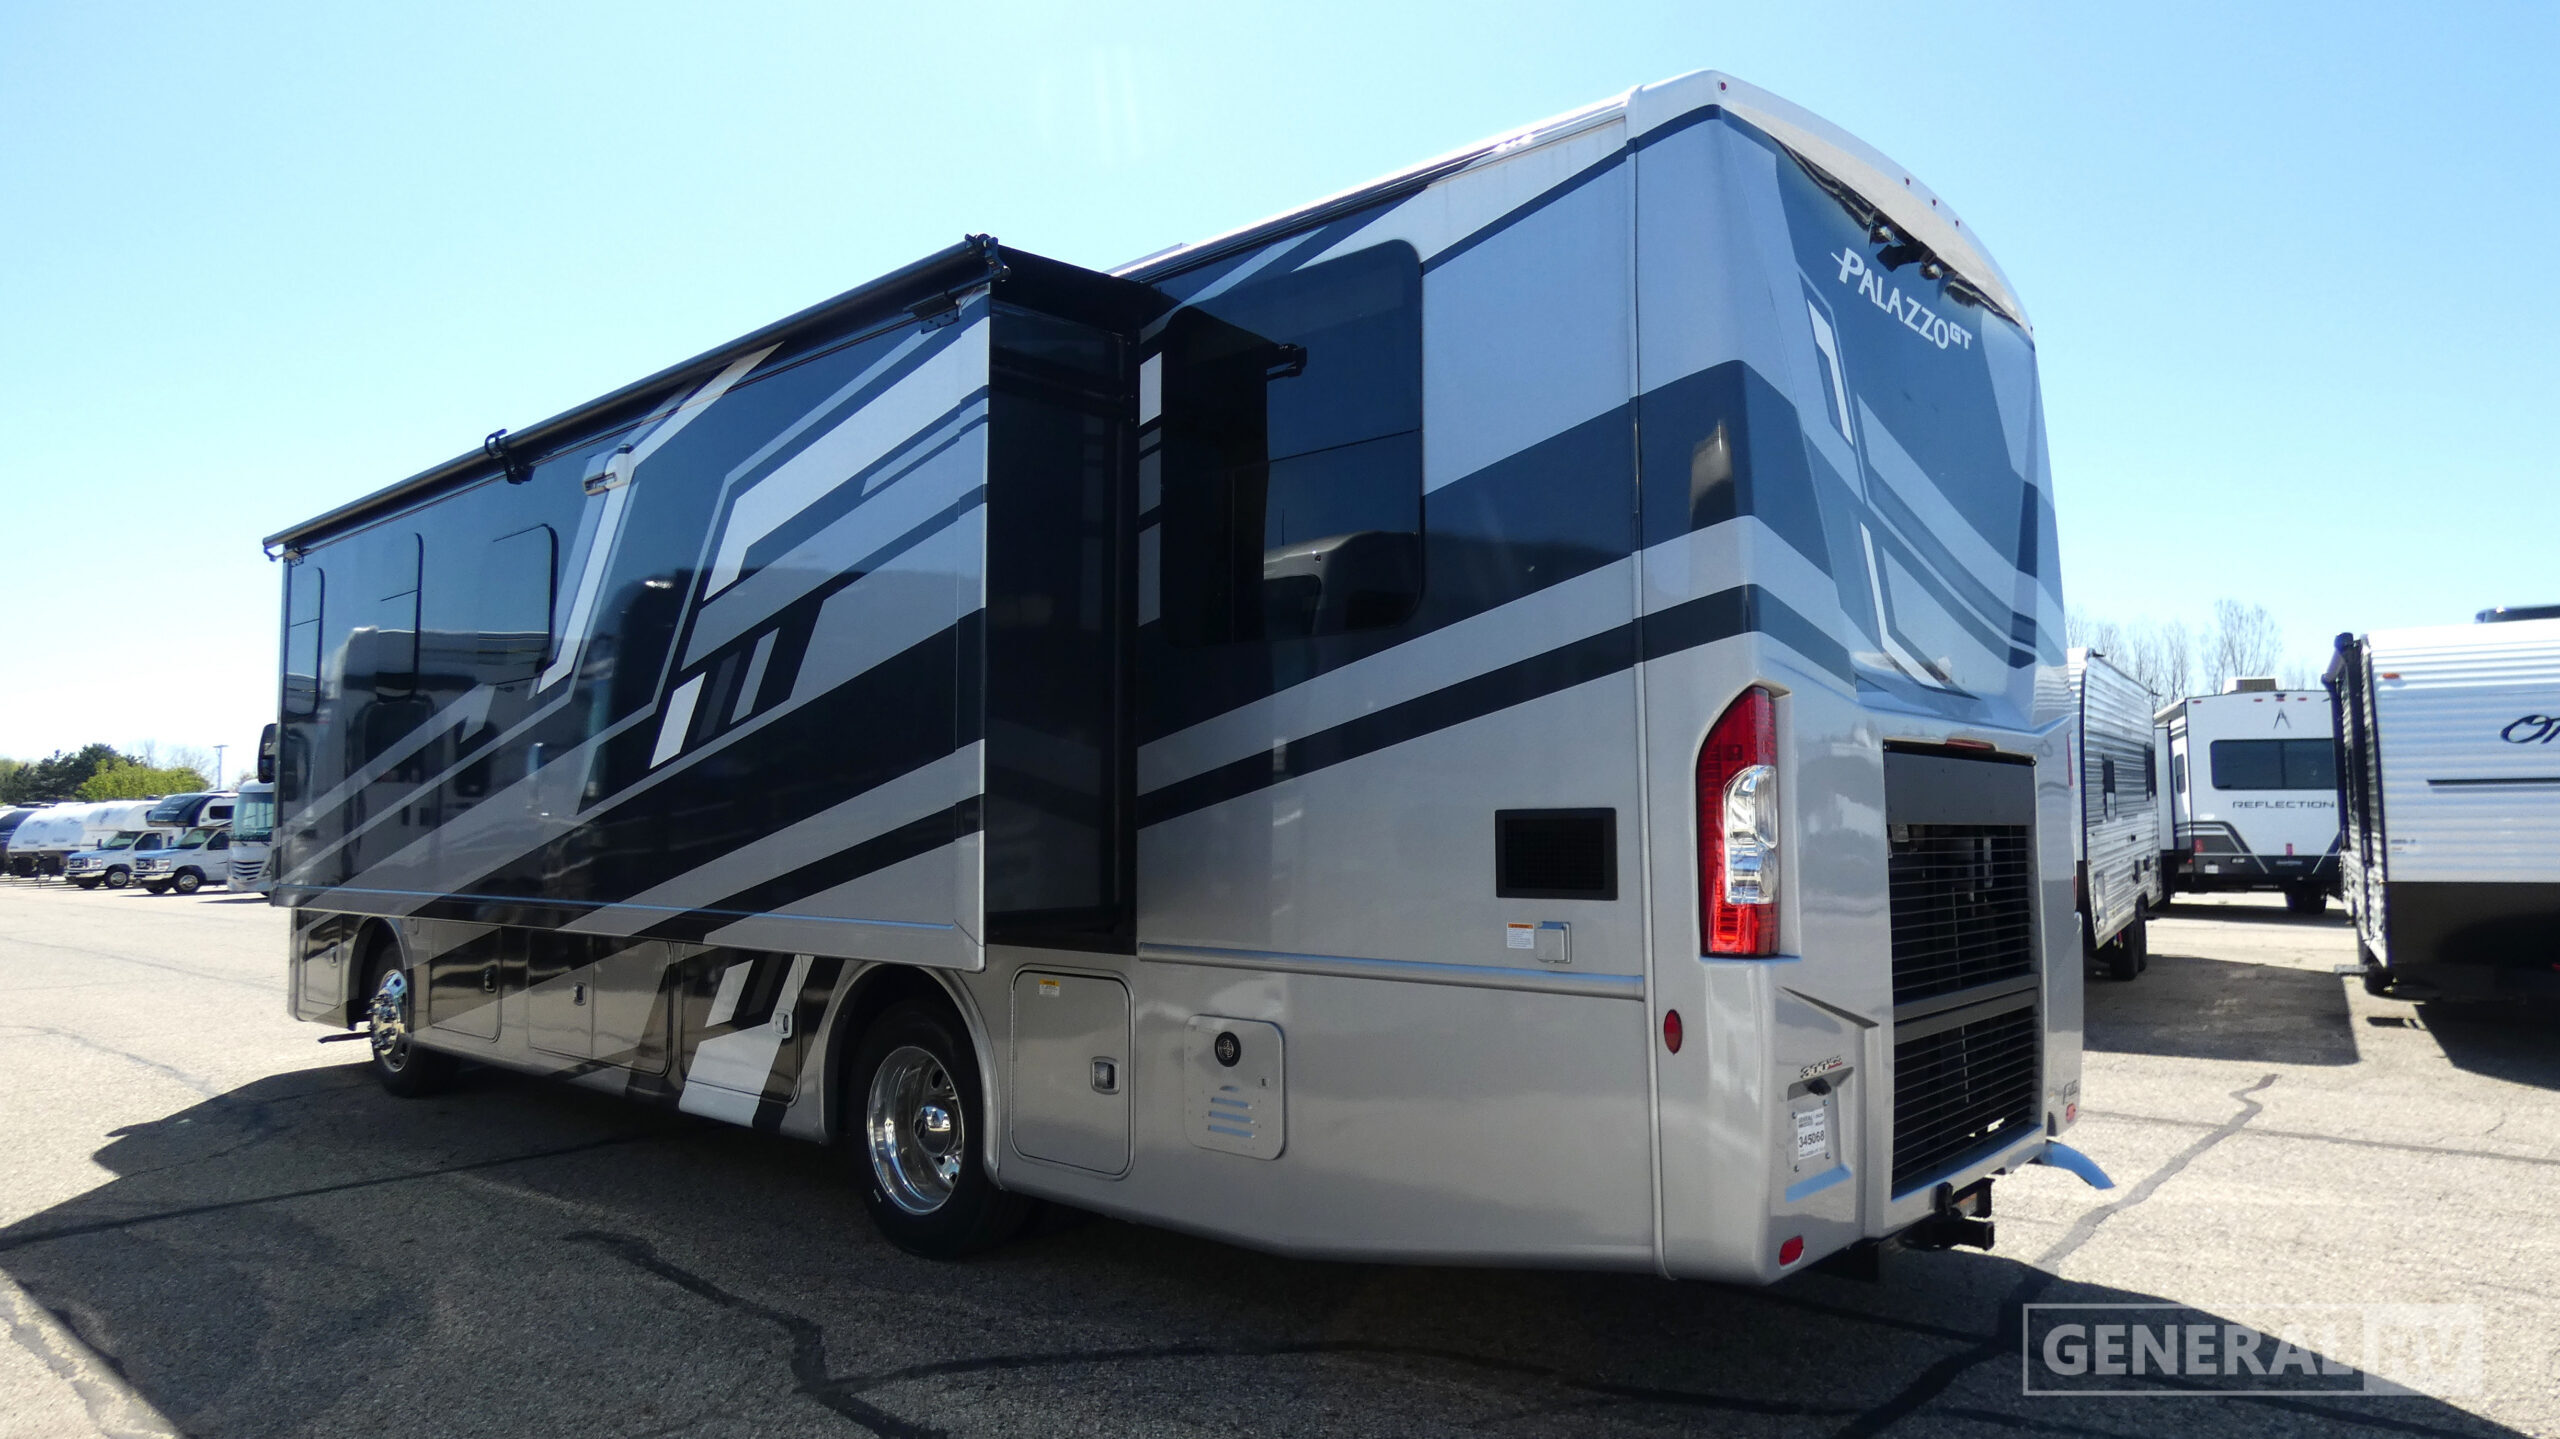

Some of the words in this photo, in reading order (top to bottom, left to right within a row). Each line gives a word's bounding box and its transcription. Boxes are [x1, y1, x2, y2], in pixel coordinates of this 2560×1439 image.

[1831, 247, 1949, 350] PALAZZO
[1949, 320, 1973, 350] GT
[2232, 800, 2336, 809] REFLECTION
[1798, 1130, 1825, 1148] 345068
